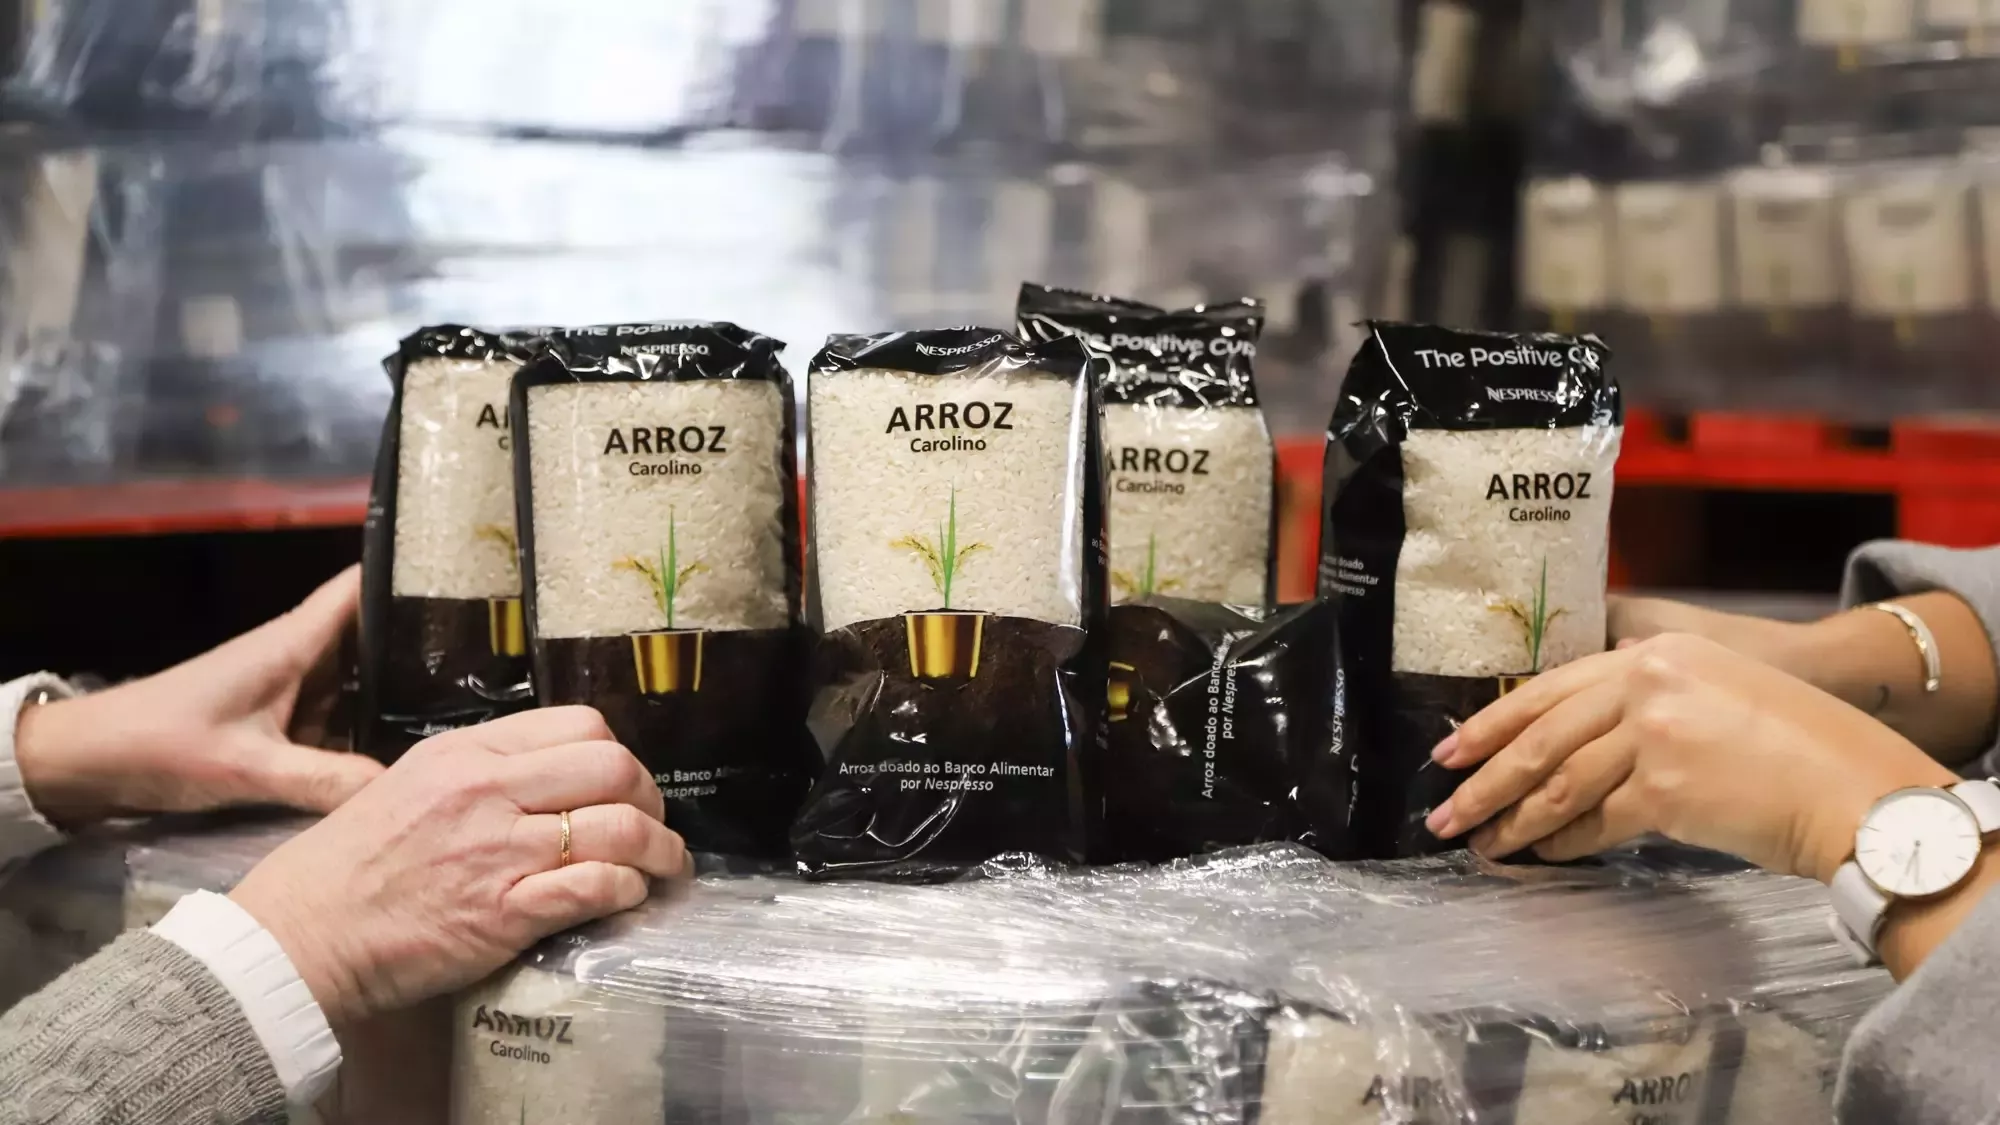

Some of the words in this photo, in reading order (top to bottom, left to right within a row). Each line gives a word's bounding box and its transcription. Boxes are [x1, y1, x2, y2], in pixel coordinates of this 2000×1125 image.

[616, 321, 712, 337] Positi
[620, 344, 709, 356] NESPRESSO
[915, 333, 1002, 356] NESPRESSO
[1111, 333, 1204, 353] Positive
[1414, 348, 1466, 368] The
[1470, 345, 1564, 367] Positive
[1485, 385, 1568, 405] NESPRESSO
[885, 401, 1014, 434] ARROZ
[603, 426, 727, 455] ARROZ
[910, 435, 987, 453] Carolino
[629, 460, 702, 476] Carolino
[1486, 472, 1592, 500] ARROZ
[1509, 506, 1571, 522] Carolino
[1208, 697, 1219, 714] ao
[1203, 717, 1218, 759] doado
[1222, 716, 1235, 740] por
[673, 769, 713, 783] Banco
[839, 762, 875, 775] Arroz
[879, 760, 921, 773] doado
[923, 763, 940, 774] ao
[944, 761, 986, 775] Banco
[989, 761, 1055, 777] Alimentar
[900, 778, 922, 792] por
[924, 777, 994, 793] Nespresso
[1202, 762, 1215, 799] Arroz
[660, 784, 718, 800] espresso
[490, 1040, 551, 1064] Carolino
